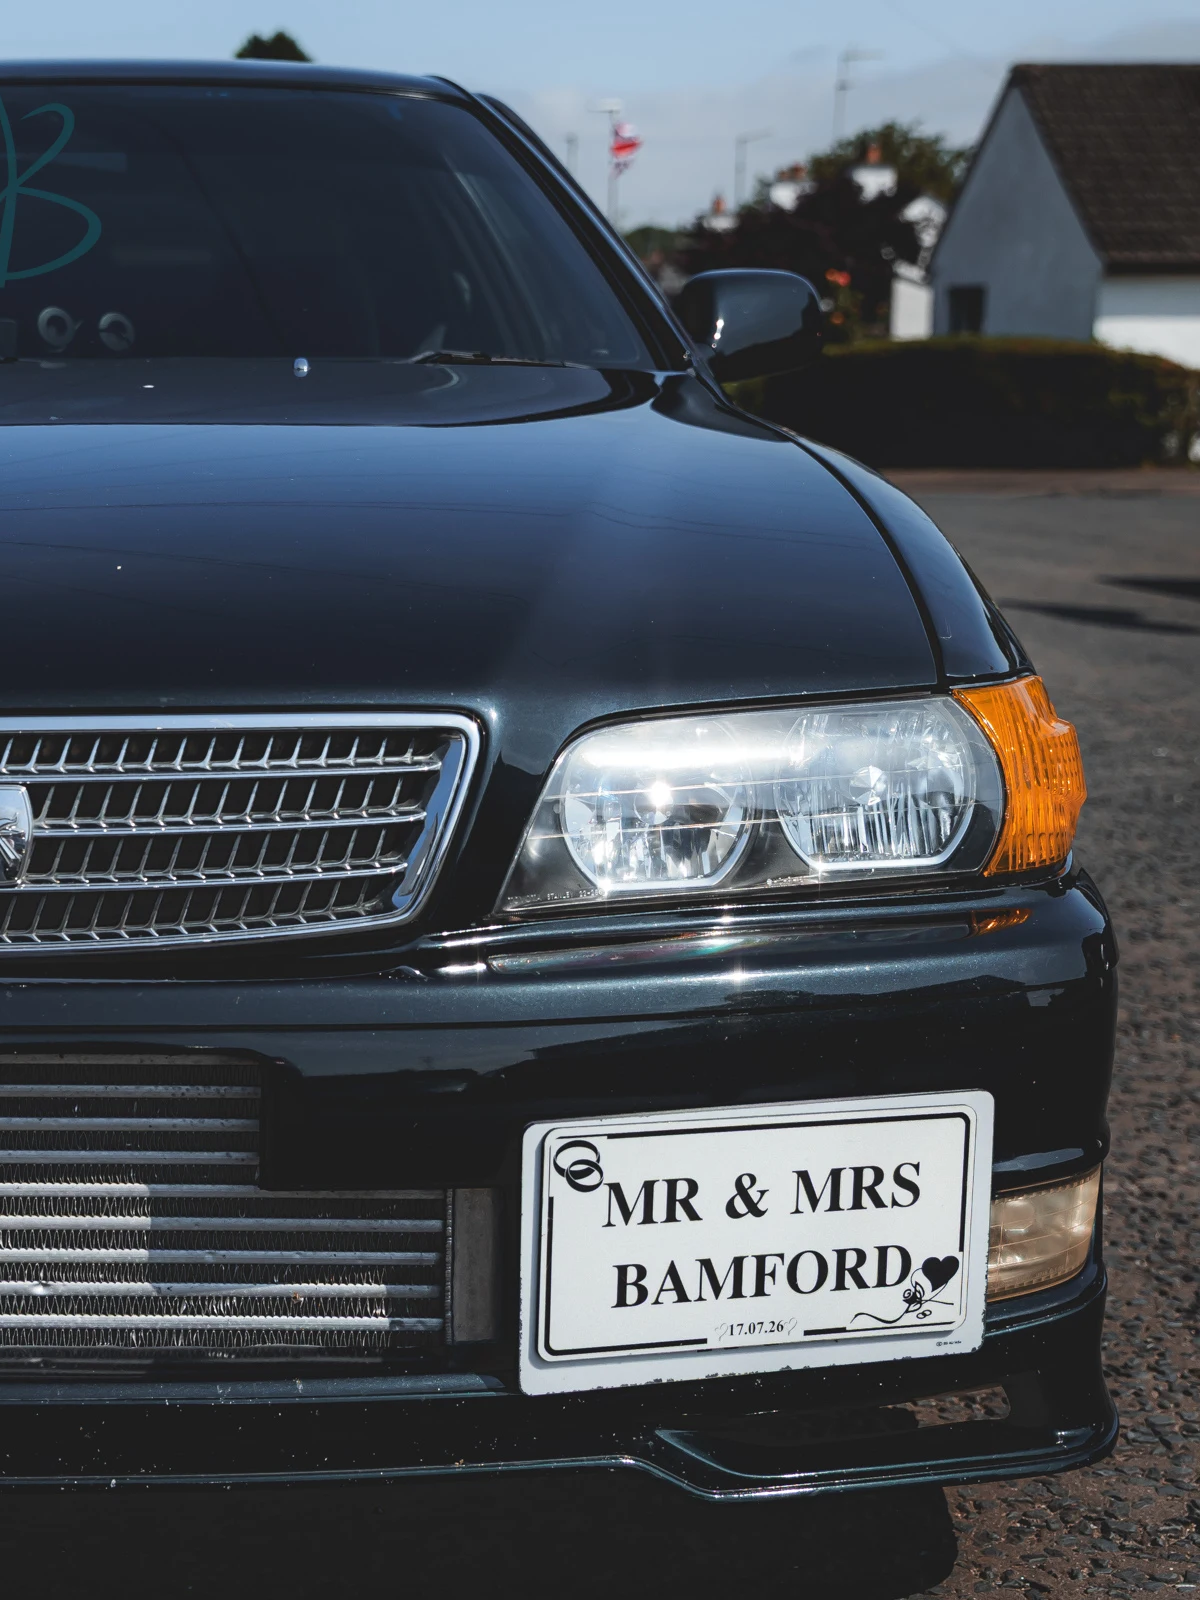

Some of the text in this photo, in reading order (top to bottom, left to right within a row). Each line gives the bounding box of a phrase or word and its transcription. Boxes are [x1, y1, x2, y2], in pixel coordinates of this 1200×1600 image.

[602, 1162, 921, 1228] MR & MRS
[611, 1244, 913, 1309] BAMFORD
[729, 1320, 784, 1336] 17.07.26
